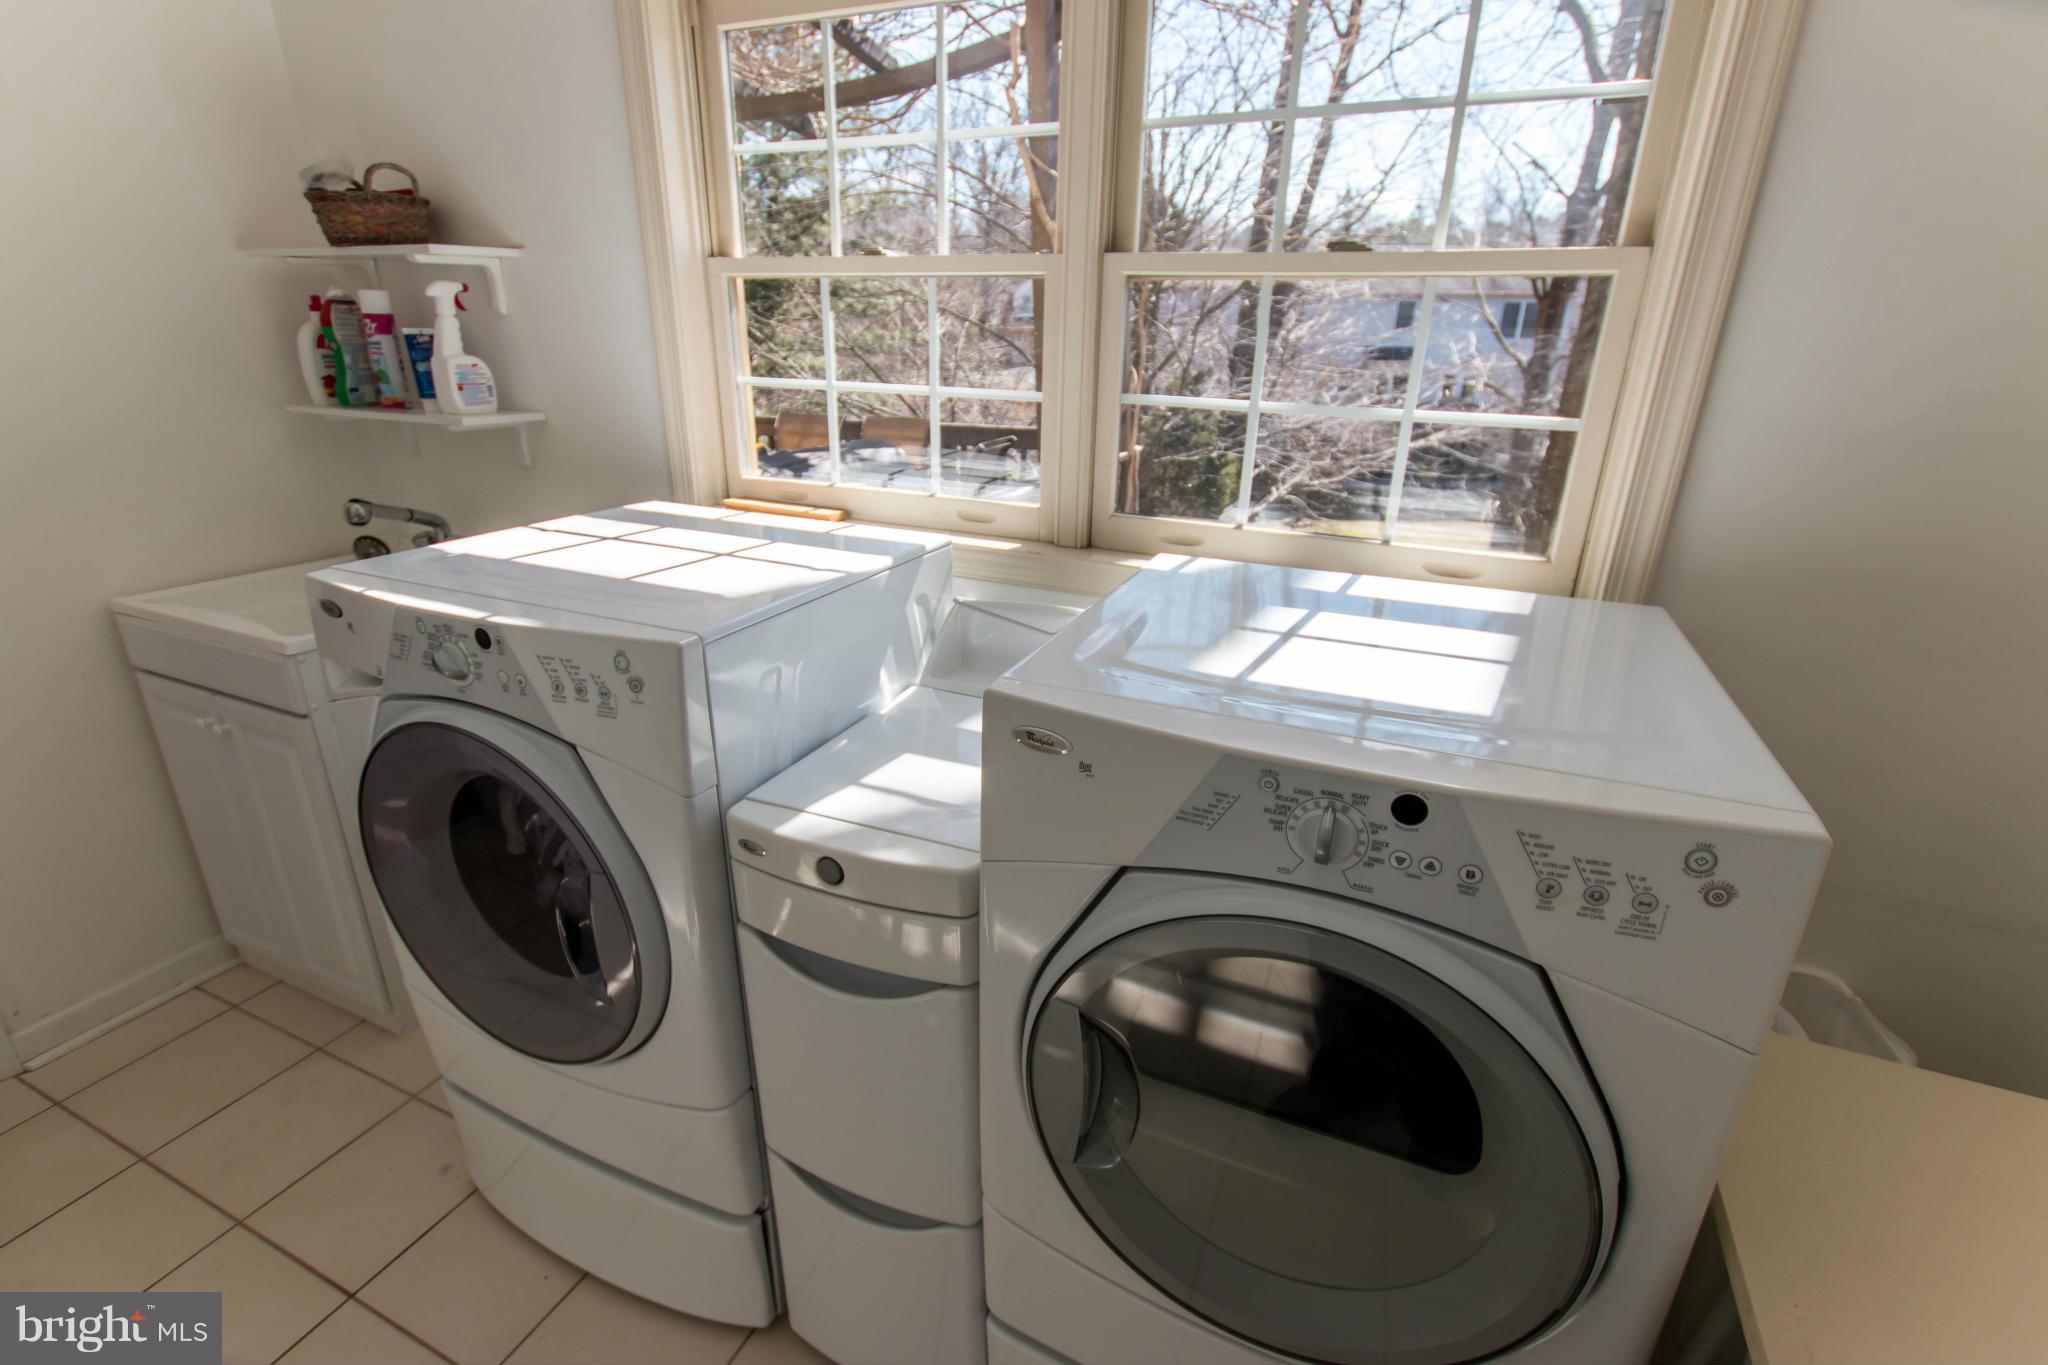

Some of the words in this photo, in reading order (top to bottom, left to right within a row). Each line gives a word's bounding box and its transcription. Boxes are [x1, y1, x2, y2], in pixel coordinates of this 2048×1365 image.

[1026, 734, 1053, 747] Whirlpool
[1293, 788, 1314, 797] CASUAL
[1321, 789, 1344, 799] NORMAL
[1275, 794, 1299, 804] DELICATE
[1264, 807, 1287, 817] DELICATE
